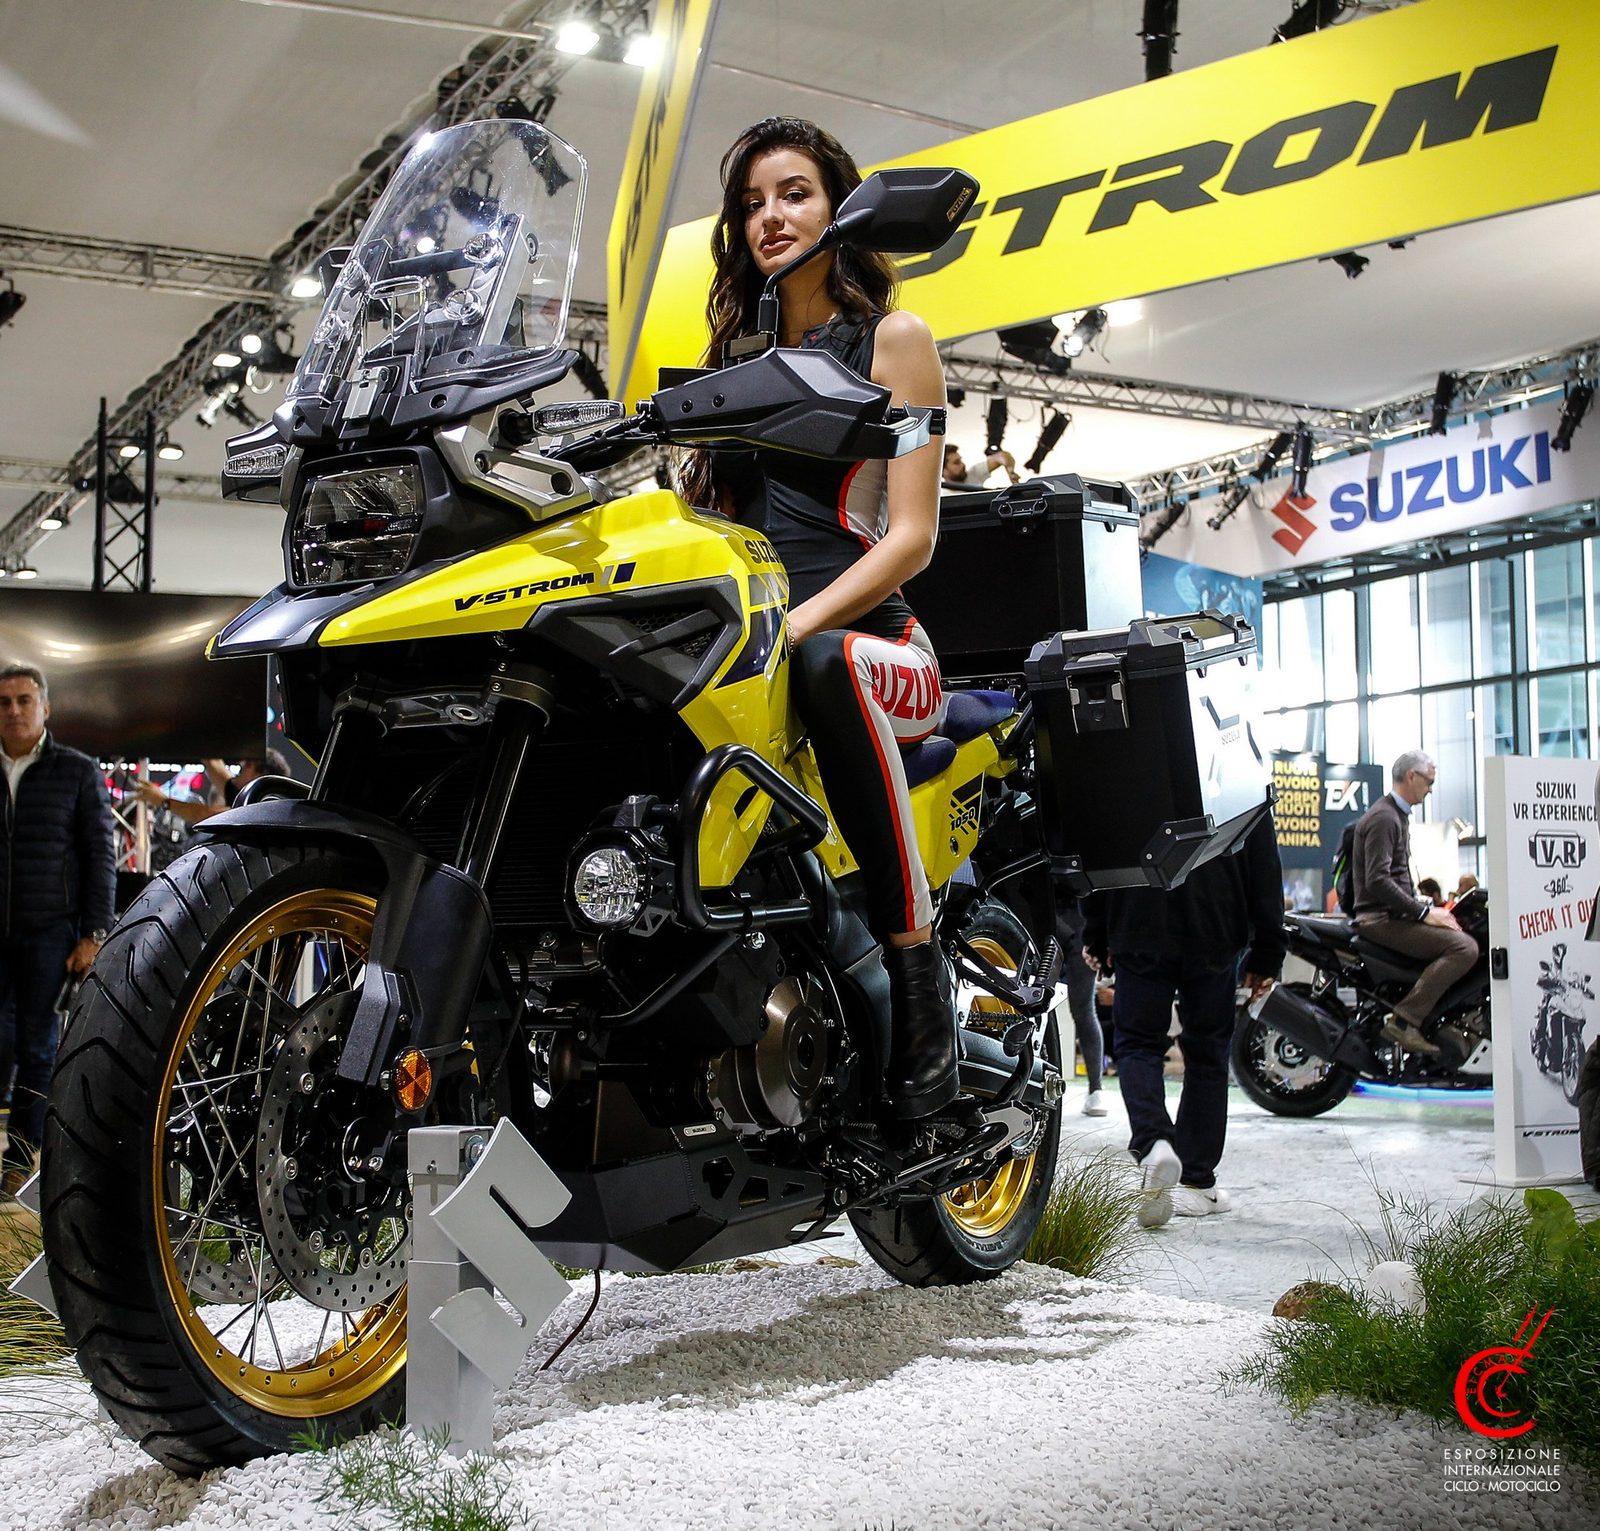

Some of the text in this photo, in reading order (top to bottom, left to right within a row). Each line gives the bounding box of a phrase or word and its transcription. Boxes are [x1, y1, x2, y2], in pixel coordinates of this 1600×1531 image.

[1329, 431, 1551, 532] SUZUKI
[454, 572, 595, 611] V-STROM
[1536, 782, 1577, 800] SUZUKI
[950, 808, 976, 831] 1050
[1513, 802, 1529, 821] VR
[1518, 907, 1558, 942] CHECK
[1561, 904, 1573, 929] IT
